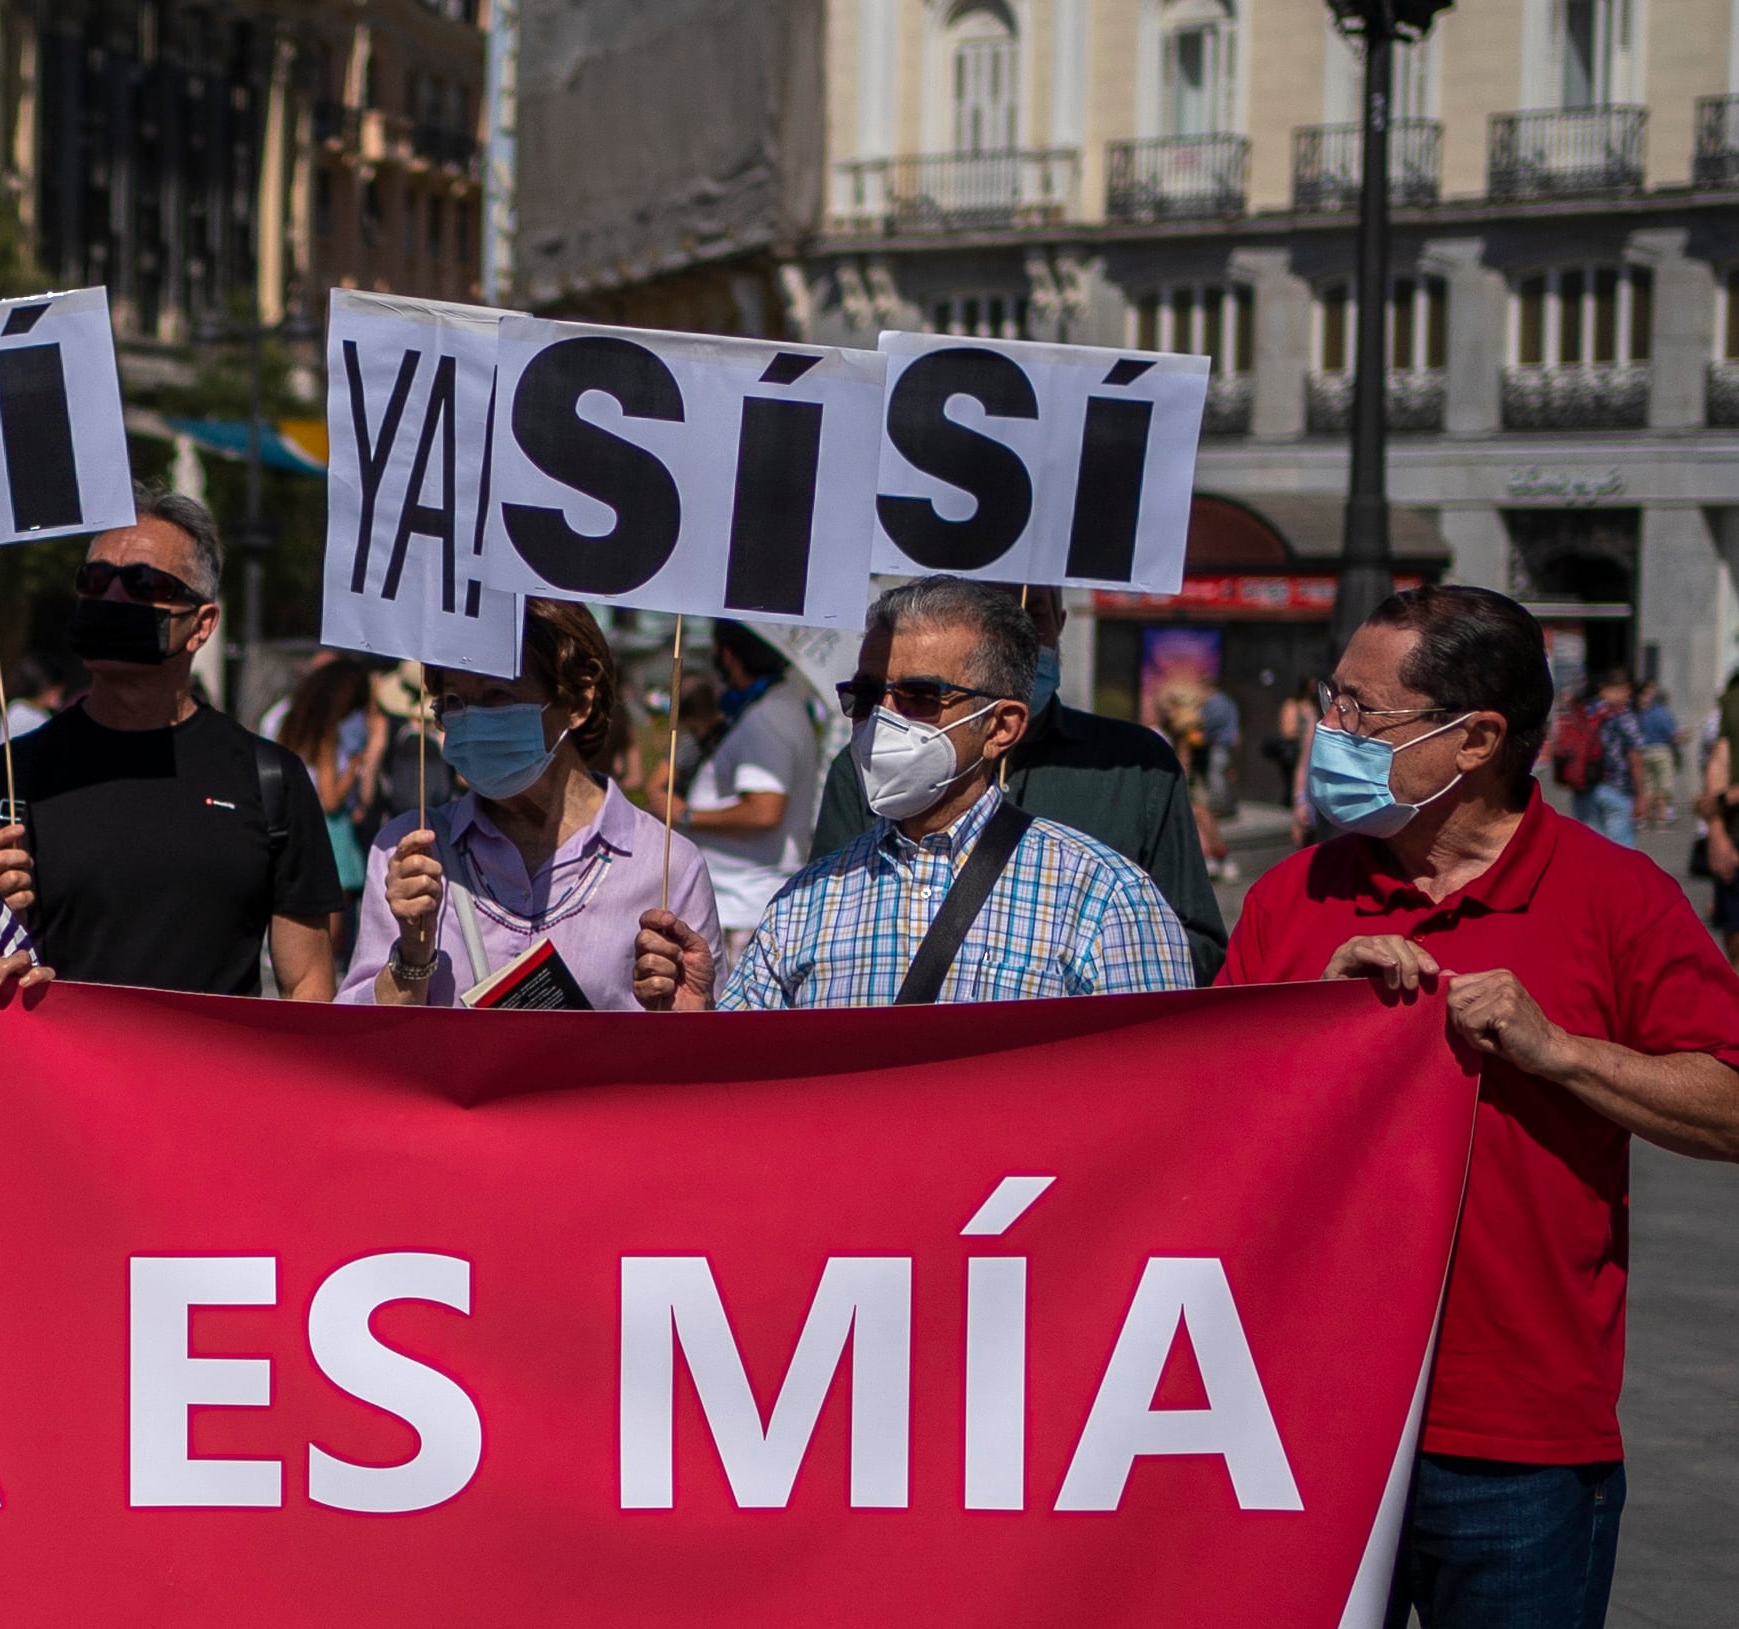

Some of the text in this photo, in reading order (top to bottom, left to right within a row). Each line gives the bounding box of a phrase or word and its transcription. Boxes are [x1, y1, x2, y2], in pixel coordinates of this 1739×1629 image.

[501, 337, 823, 616] SÍ
[876, 348, 1157, 582] SÍ
[130, 1253, 482, 1512] ES
[621, 1176, 1305, 1511] MÍA
